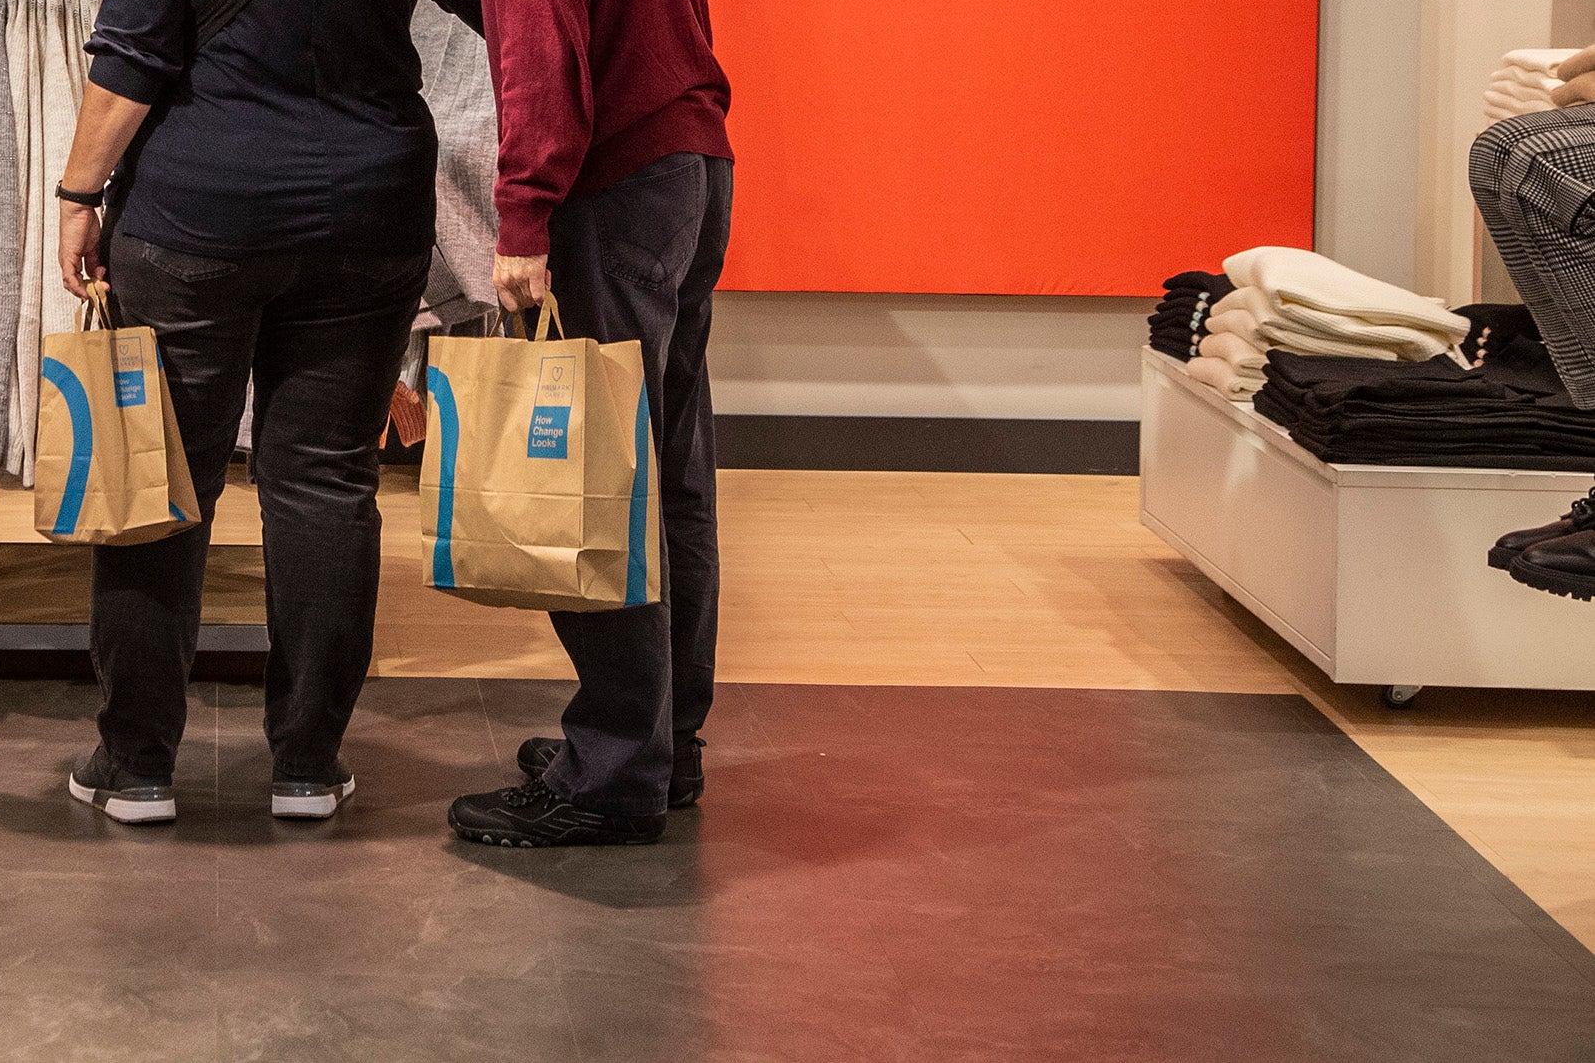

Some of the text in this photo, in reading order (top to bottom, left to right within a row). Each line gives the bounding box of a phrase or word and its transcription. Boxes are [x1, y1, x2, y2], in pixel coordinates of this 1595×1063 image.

[535, 415, 553, 425] How
[533, 426, 563, 438] Change
[532, 438, 556, 448] Looks
